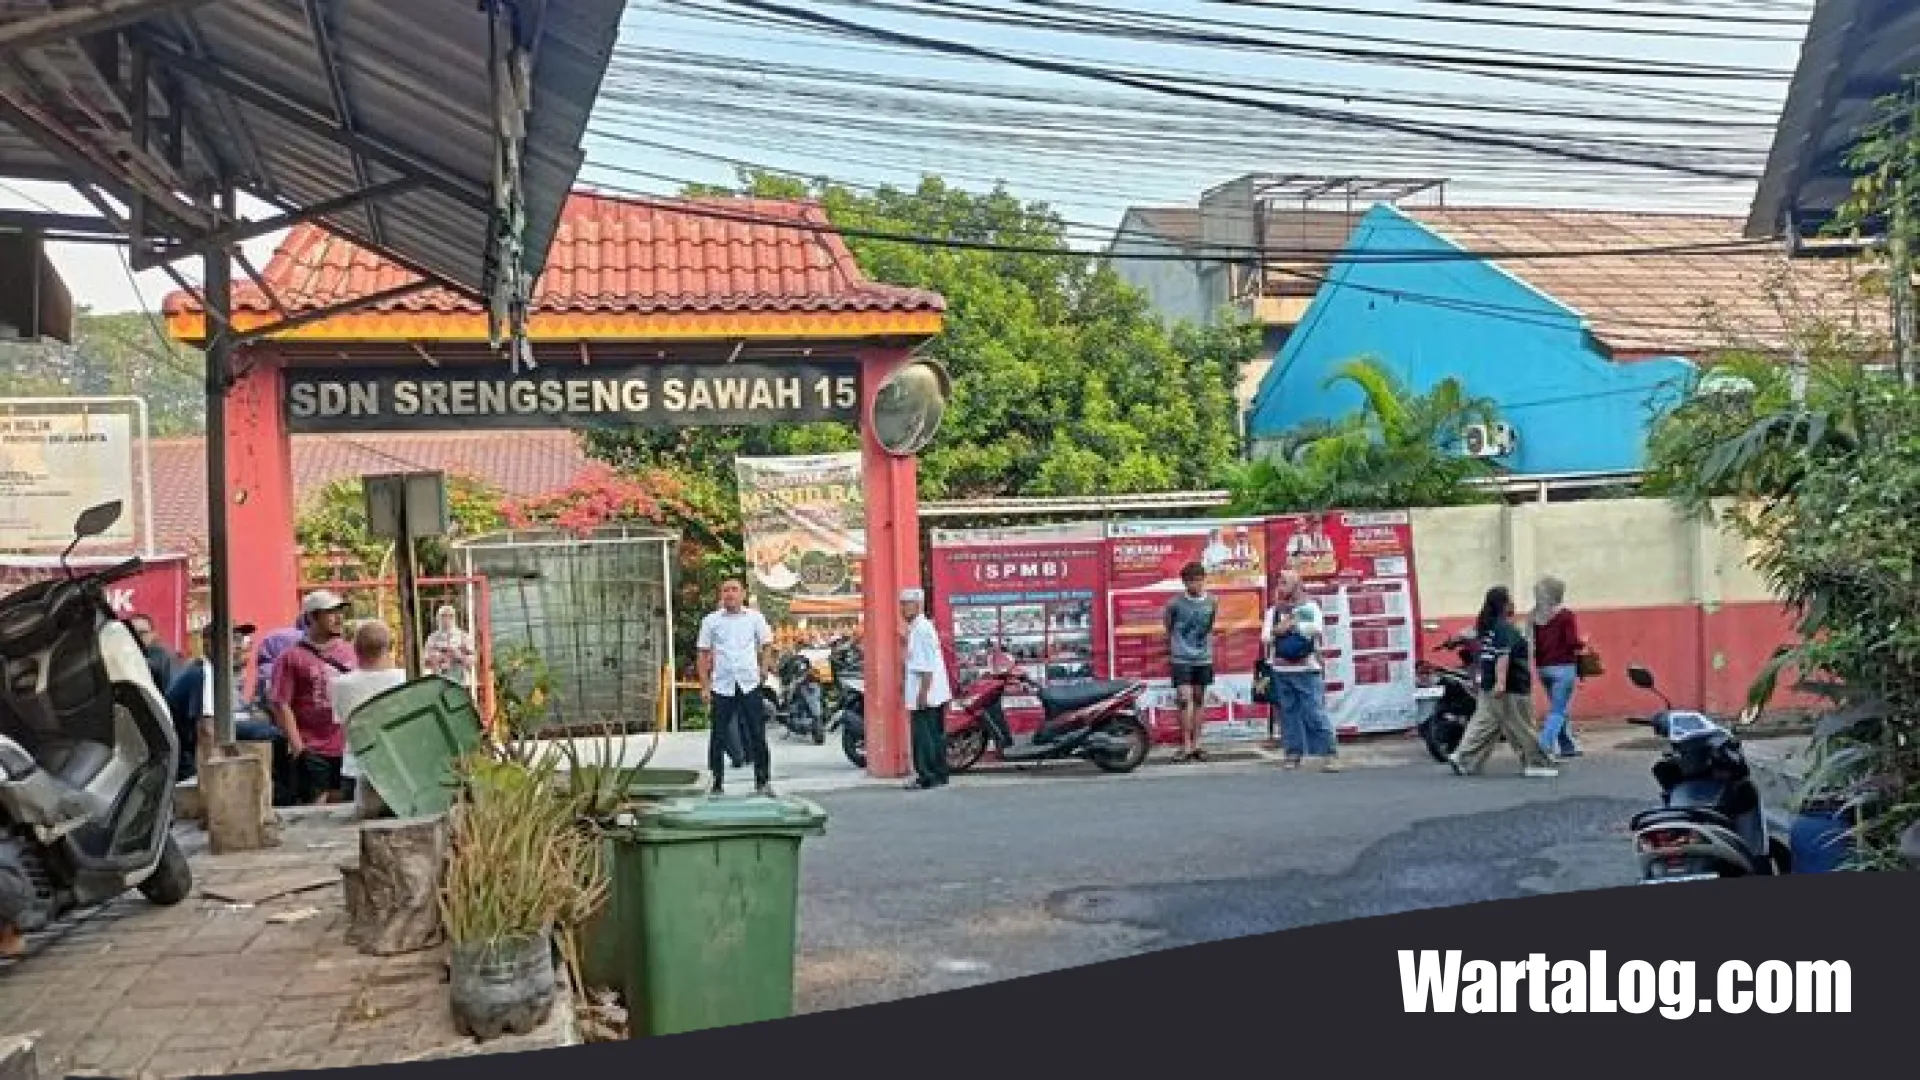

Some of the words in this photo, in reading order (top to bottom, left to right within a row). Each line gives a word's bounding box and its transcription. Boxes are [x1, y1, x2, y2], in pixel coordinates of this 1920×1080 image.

[290, 382, 379, 417] SDN
[393, 379, 649, 416] SRENGSENG
[663, 376, 801, 412] SAWAH
[815, 374, 855, 409] 15
[67, 433, 107, 444] JAKARTA
